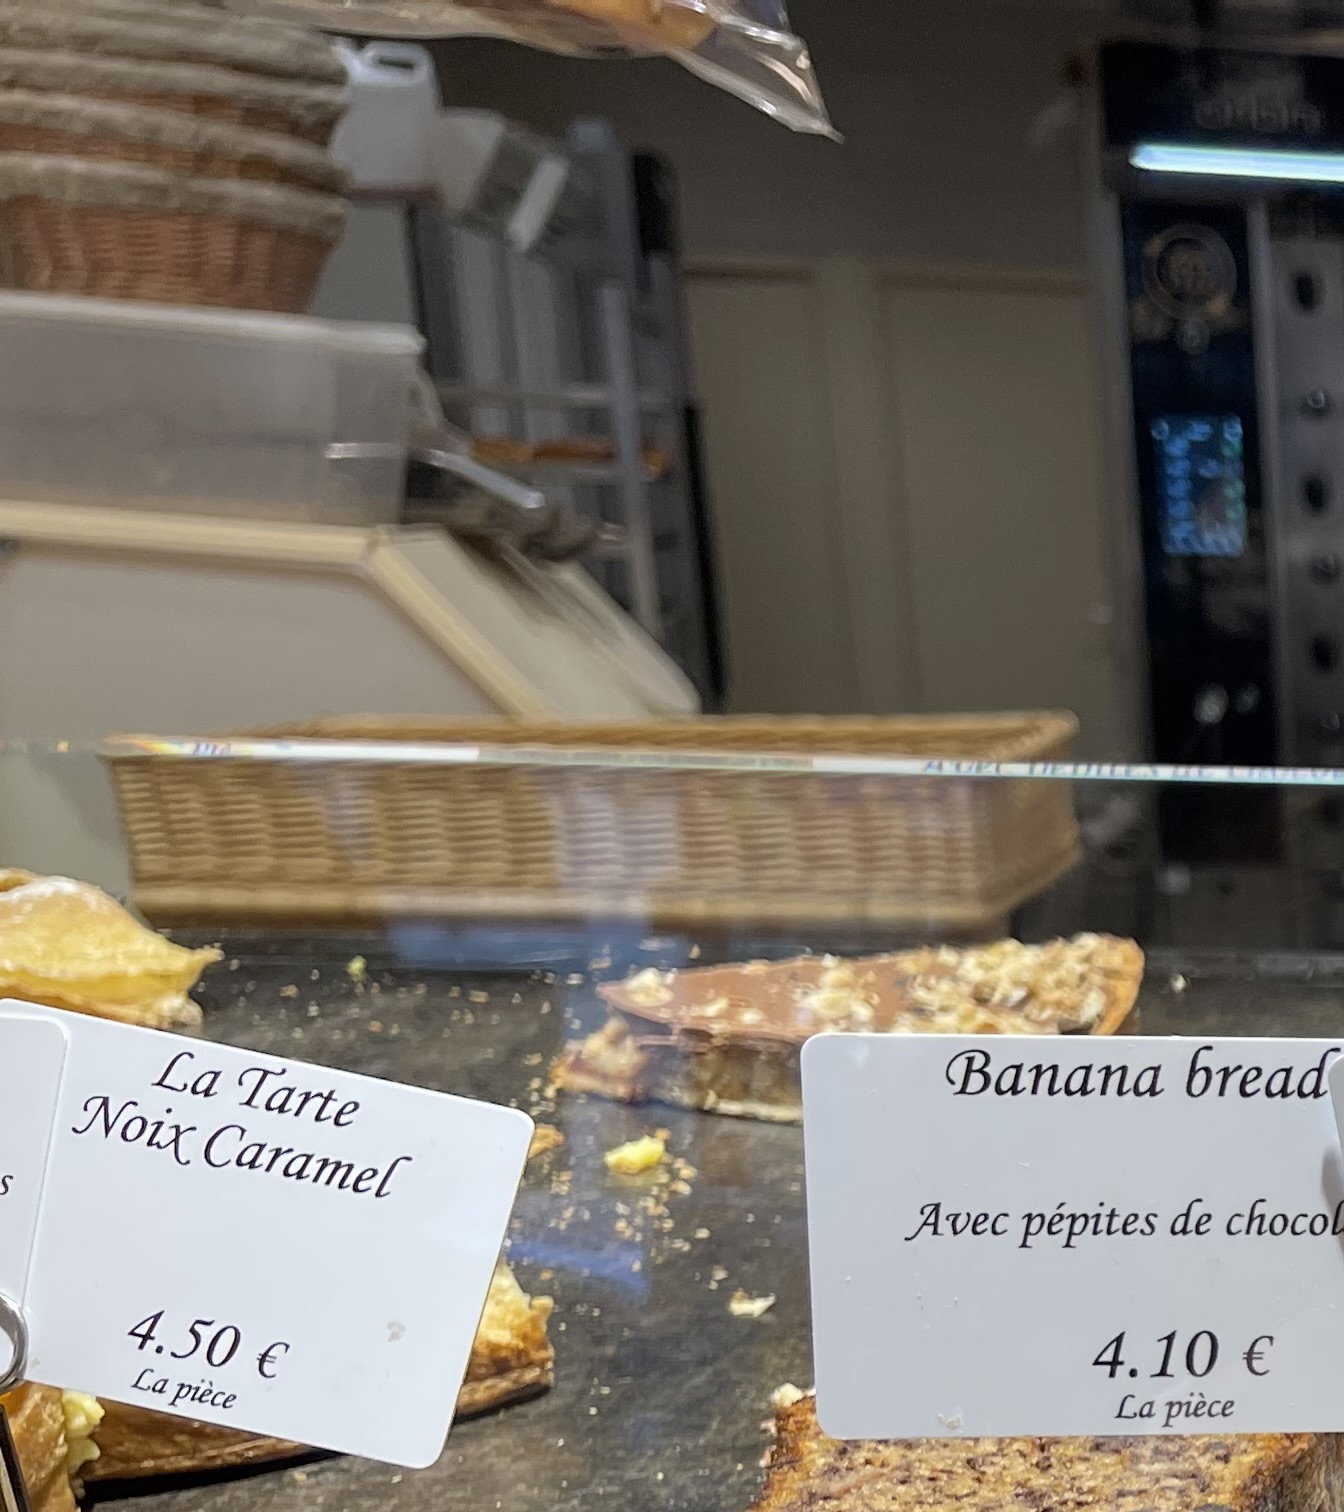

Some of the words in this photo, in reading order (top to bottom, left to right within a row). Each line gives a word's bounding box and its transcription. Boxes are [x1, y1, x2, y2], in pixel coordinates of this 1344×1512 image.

[150, 1051, 223, 1099] La
[237, 1064, 361, 1128] Tarte
[945, 1048, 1165, 1098] Banana
[1185, 1045, 1341, 1100] bread
[71, 1095, 198, 1166] Noix
[203, 1124, 413, 1199] Caramel
[903, 1201, 1010, 1242] Avec
[1018, 1201, 1159, 1249] pépites
[1169, 1197, 1213, 1237] de
[127, 1309, 242, 1368] 4.50
[256, 1341, 291, 1379] €
[1091, 1329, 1219, 1379] 4.10
[1242, 1335, 1275, 1377] €
[130, 1368, 170, 1394] La
[168, 1378, 238, 1409] pièce
[1114, 1394, 1156, 1420] La
[1162, 1391, 1235, 1428] pièce
